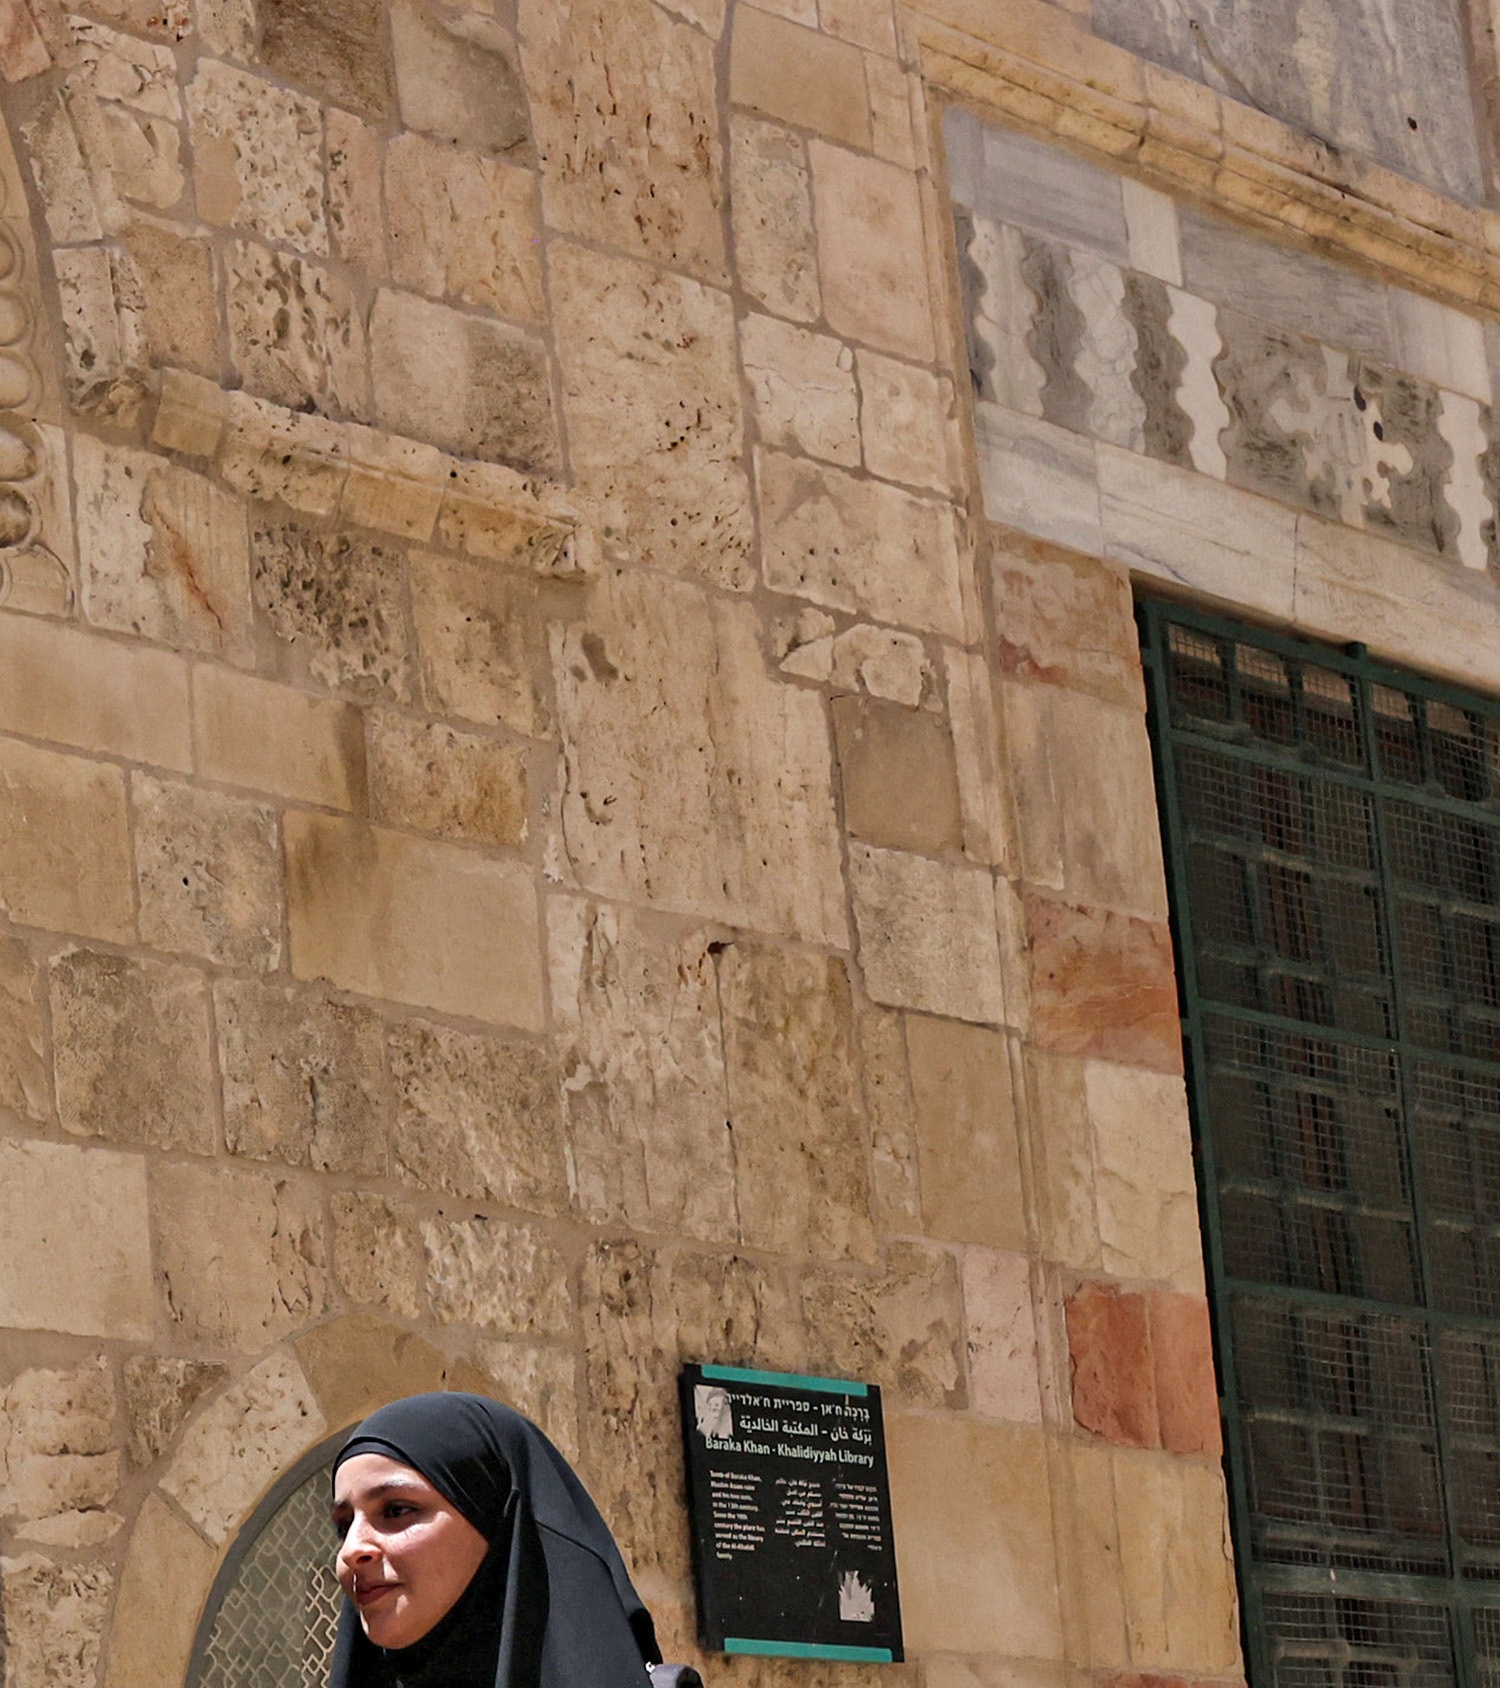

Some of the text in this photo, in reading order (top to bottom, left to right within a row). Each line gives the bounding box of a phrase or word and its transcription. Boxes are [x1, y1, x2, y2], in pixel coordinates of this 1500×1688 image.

[782, 1419, 819, 1438] المكتبة
[705, 1435, 741, 1452] Baraka
[743, 1440, 771, 1455] Khan
[778, 1444, 838, 1463] Khalidiyyah
[838, 1449, 874, 1468] Library
